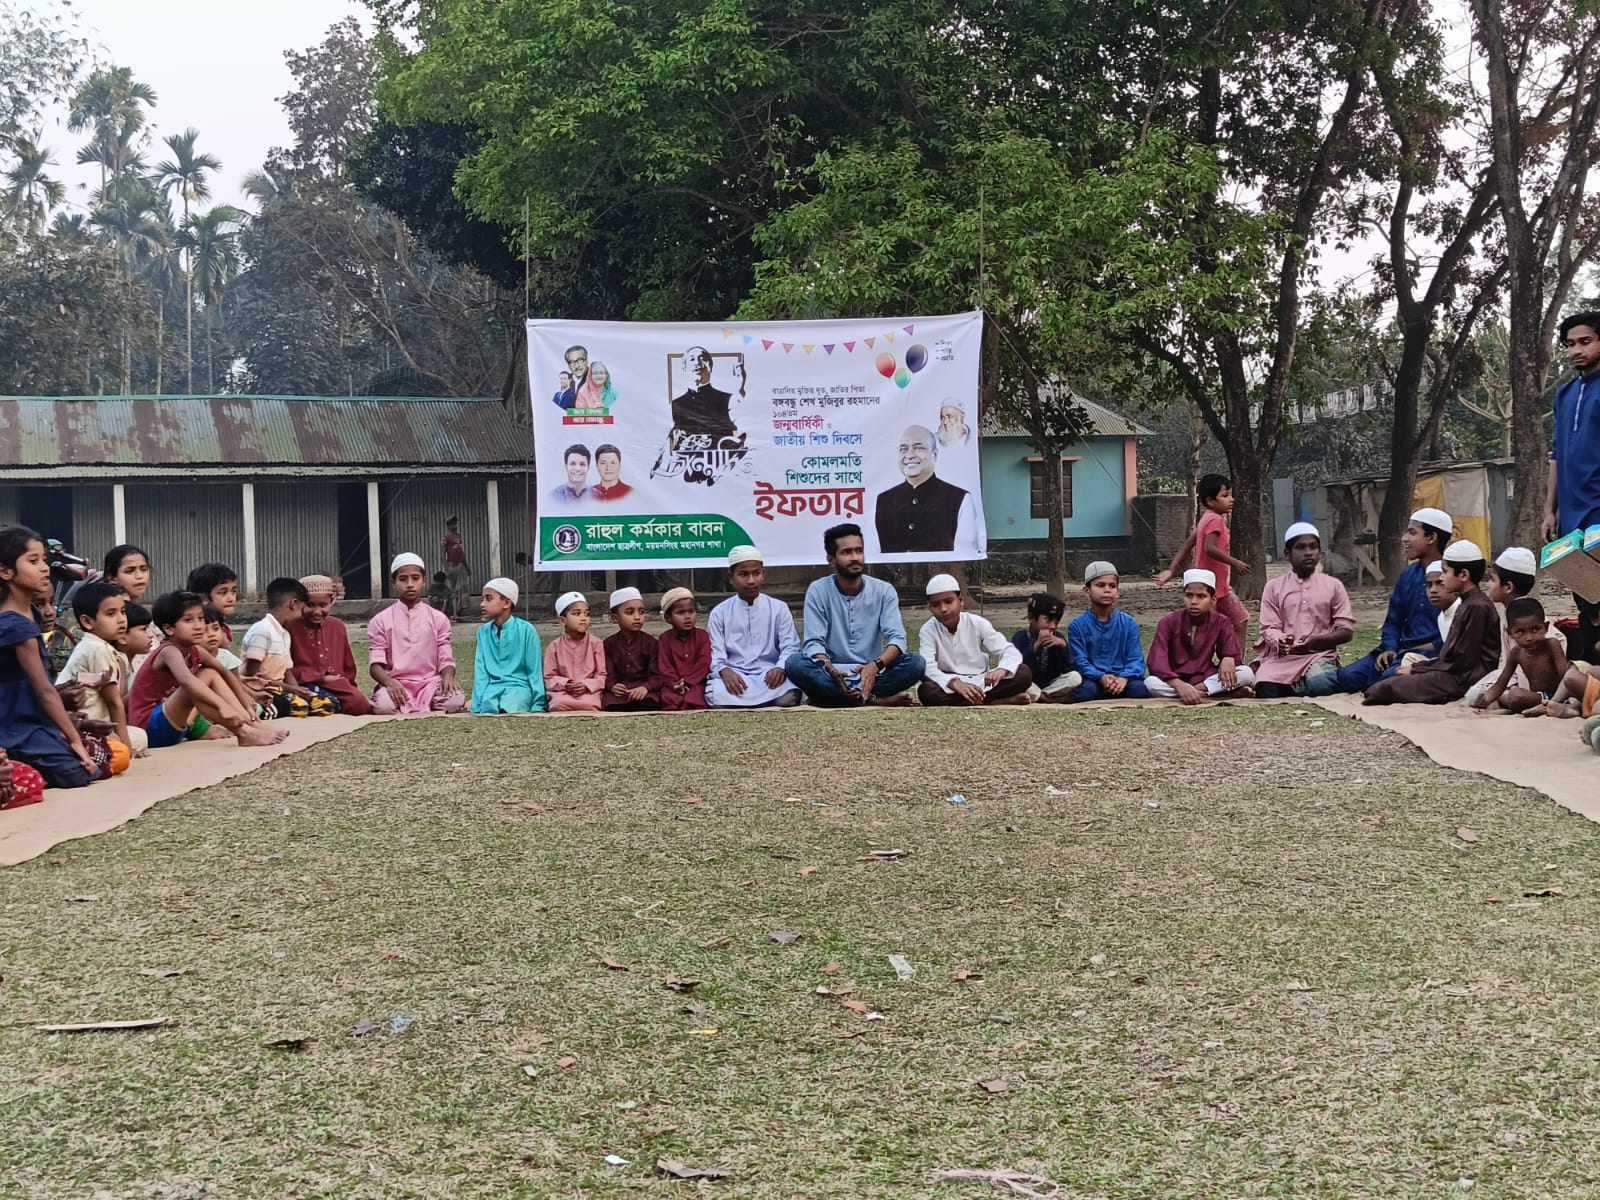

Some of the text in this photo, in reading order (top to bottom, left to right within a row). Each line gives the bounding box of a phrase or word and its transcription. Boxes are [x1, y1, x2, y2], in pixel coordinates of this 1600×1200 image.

[771, 394, 880, 409] বঙ্গবন্ধু শেখ মুজিবুর রহমানের
[772, 414, 824, 431] জন্মবার্ষিকী
[773, 430, 863, 446] জাতীয় শিশু দিবসে
[801, 451, 863, 468] কোমলমতি
[785, 468, 863, 485] শিশুদের সাথে
[753, 480, 866, 521] ইফতার
[584, 517, 725, 541] রাহুল কর্মকার বাবন
[585, 542, 616, 551] বাংলাদেশ
[679, 540, 705, 550] মহানগর
